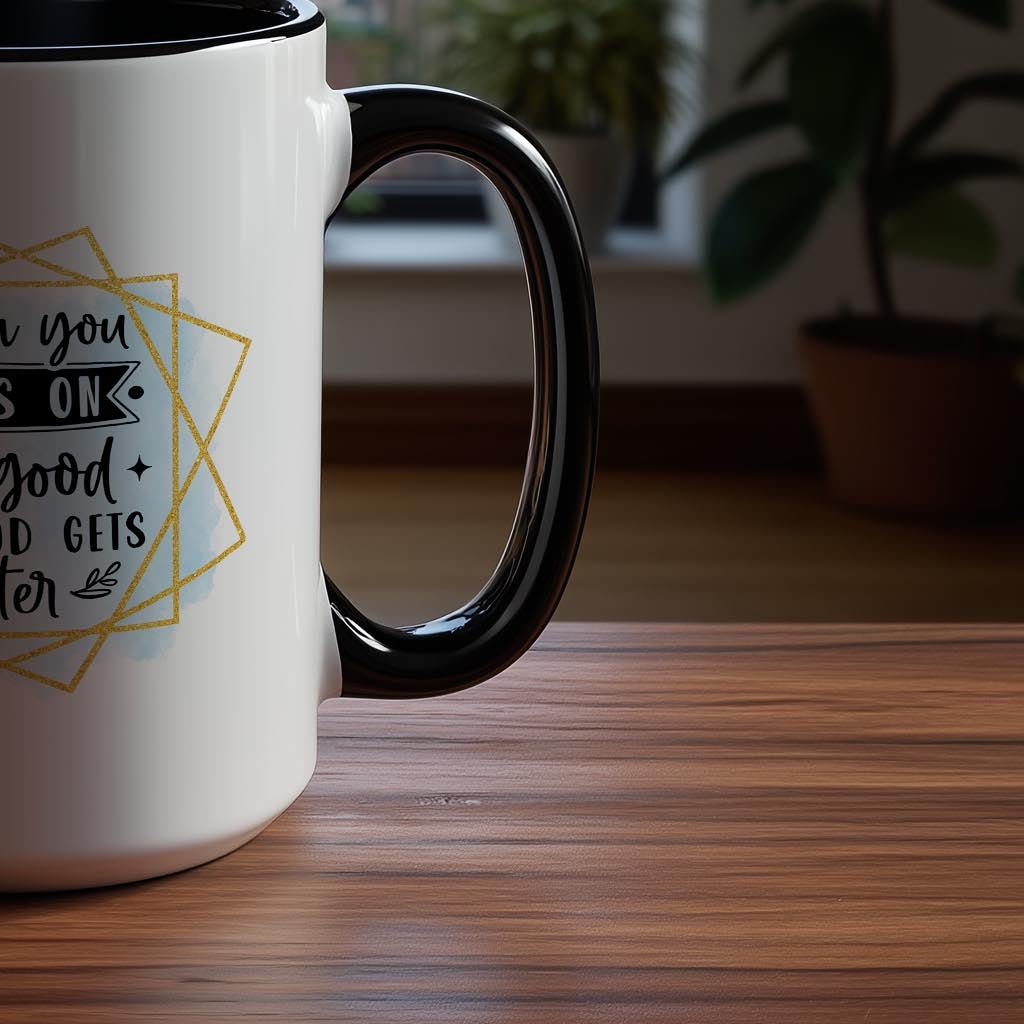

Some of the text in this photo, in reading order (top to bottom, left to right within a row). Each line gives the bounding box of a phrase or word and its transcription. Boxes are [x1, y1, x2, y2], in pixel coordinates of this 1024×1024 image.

[39, 312, 129, 366] you
[49, 376, 100, 419] ON
[63, 511, 145, 553] GETS
